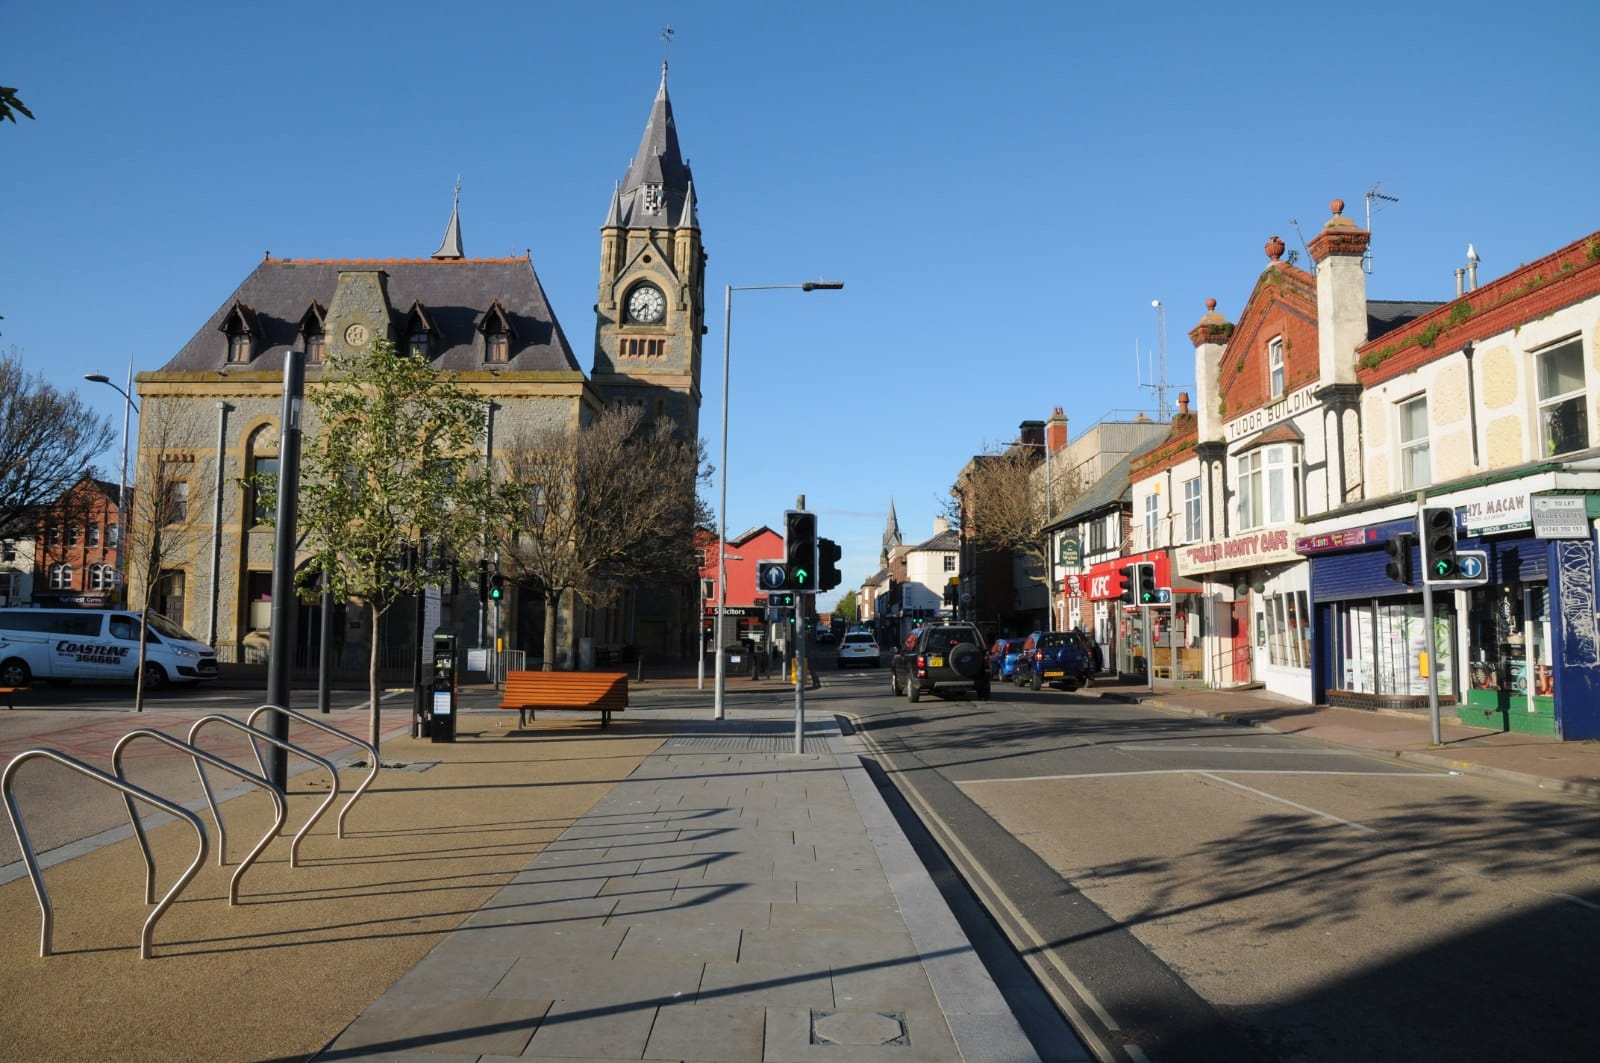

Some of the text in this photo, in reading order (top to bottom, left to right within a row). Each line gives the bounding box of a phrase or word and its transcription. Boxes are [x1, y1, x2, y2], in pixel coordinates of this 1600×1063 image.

[1230, 412, 1262, 438] TUDOR
[1487, 496, 1524, 514] MACAW
[1224, 535, 1258, 558] MONTY
[1261, 530, 1288, 552] CAFE
[1091, 575, 1110, 598] KFC
